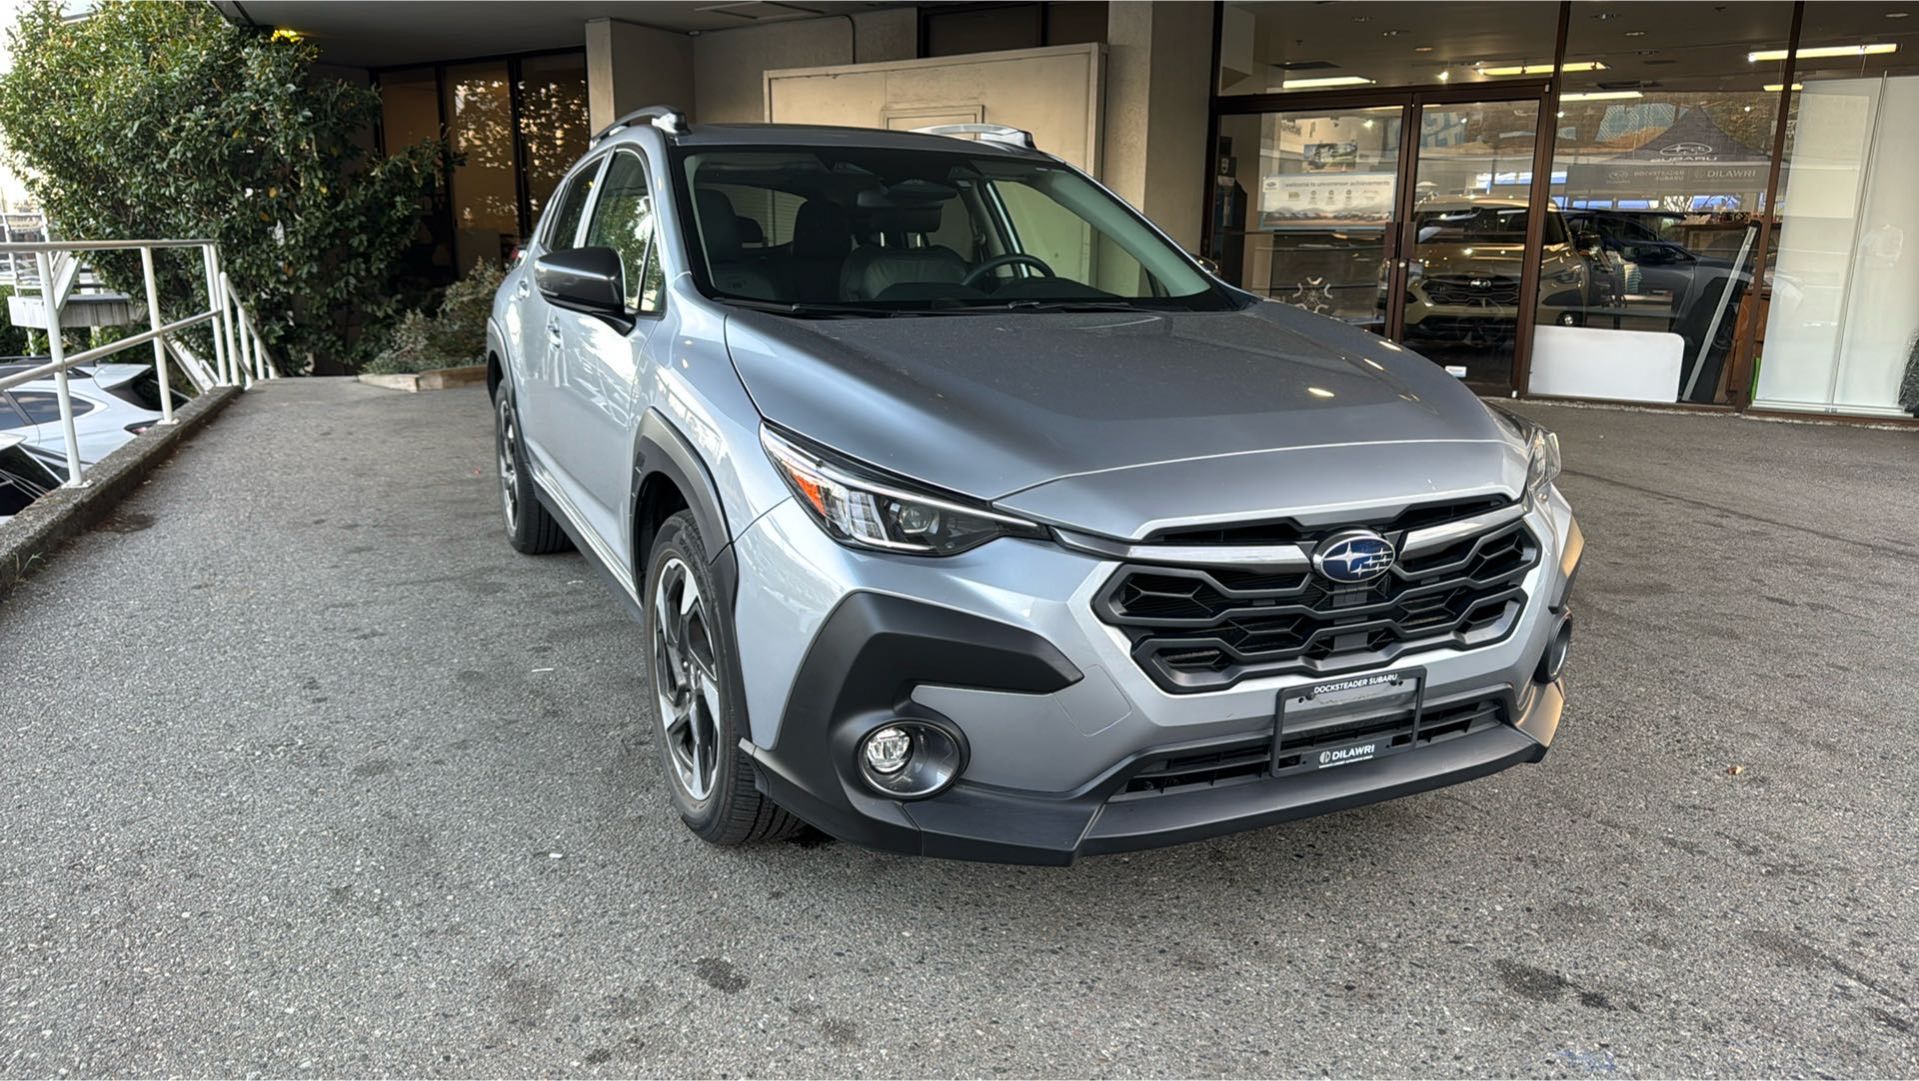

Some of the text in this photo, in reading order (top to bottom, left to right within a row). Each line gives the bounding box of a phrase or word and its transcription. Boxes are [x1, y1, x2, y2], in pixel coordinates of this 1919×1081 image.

[1707, 168, 1756, 178] DILAWRI
[1313, 673, 1398, 694] DOCKSTEADER SUBARU
[1331, 744, 1375, 760] DILAWRI
